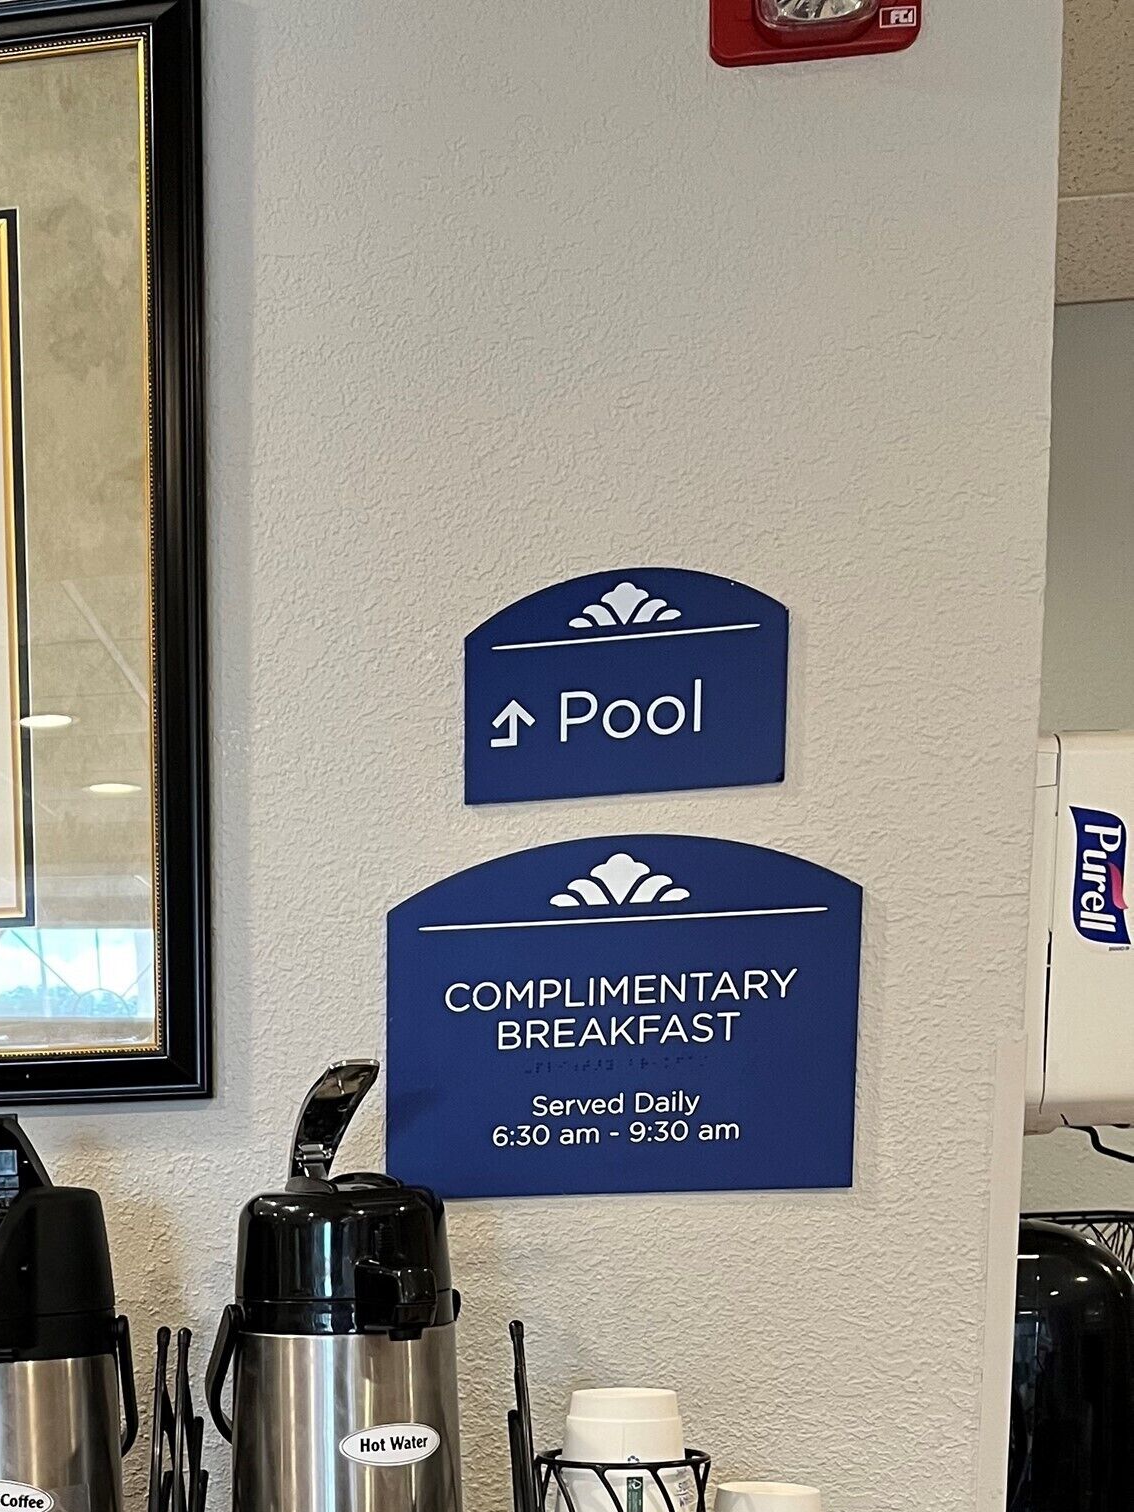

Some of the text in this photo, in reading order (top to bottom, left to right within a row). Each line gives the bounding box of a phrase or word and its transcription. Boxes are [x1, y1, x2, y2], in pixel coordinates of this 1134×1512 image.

[560, 679, 702, 742] Pool
[1079, 824, 1122, 932] Purell
[445, 968, 798, 1012] COMPLIMENTARY
[497, 1011, 741, 1050] BREAKFAST
[532, 1090, 700, 1116] Served Daily
[492, 1124, 551, 1147] 6:30
[559, 1126, 600, 1145] am
[629, 1120, 689, 1143] 9:30
[698, 1122, 739, 1140] am
[360, 1435, 428, 1453] Hot Water
[0, 1493, 44, 1509] Coffee
